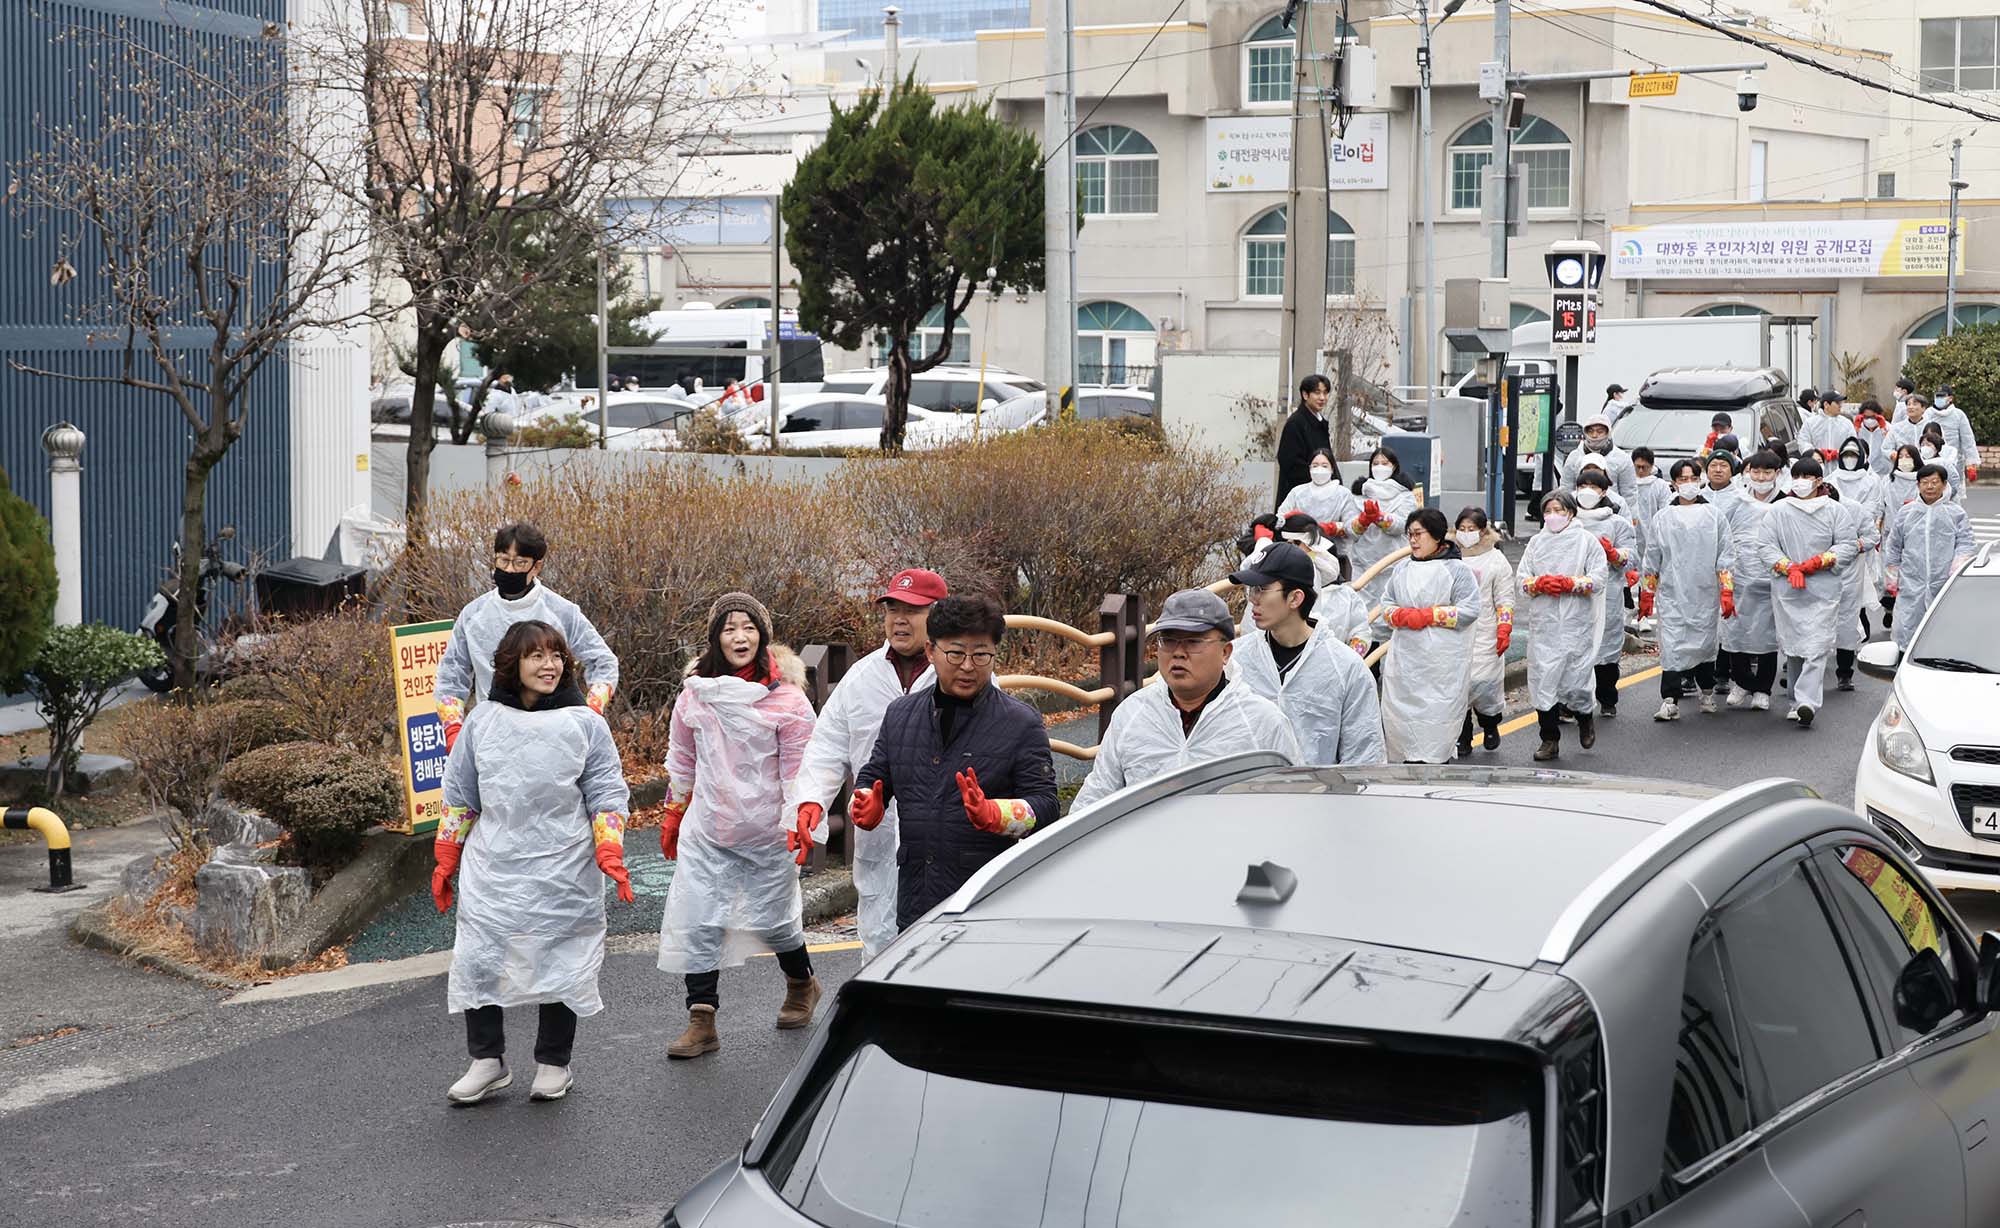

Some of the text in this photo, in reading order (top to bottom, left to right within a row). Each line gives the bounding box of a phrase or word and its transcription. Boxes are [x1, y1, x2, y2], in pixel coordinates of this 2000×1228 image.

[1230, 143, 1374, 163] 대전광역시립 린이집
[1657, 239, 1872, 257] 대화동 주민자치회 위원 공개모집
[1556, 299, 1582, 311] PM2.5
[1561, 311, 1576, 328] 15
[403, 674, 438, 698] 견인조
[1985, 811, 1998, 831] 4
